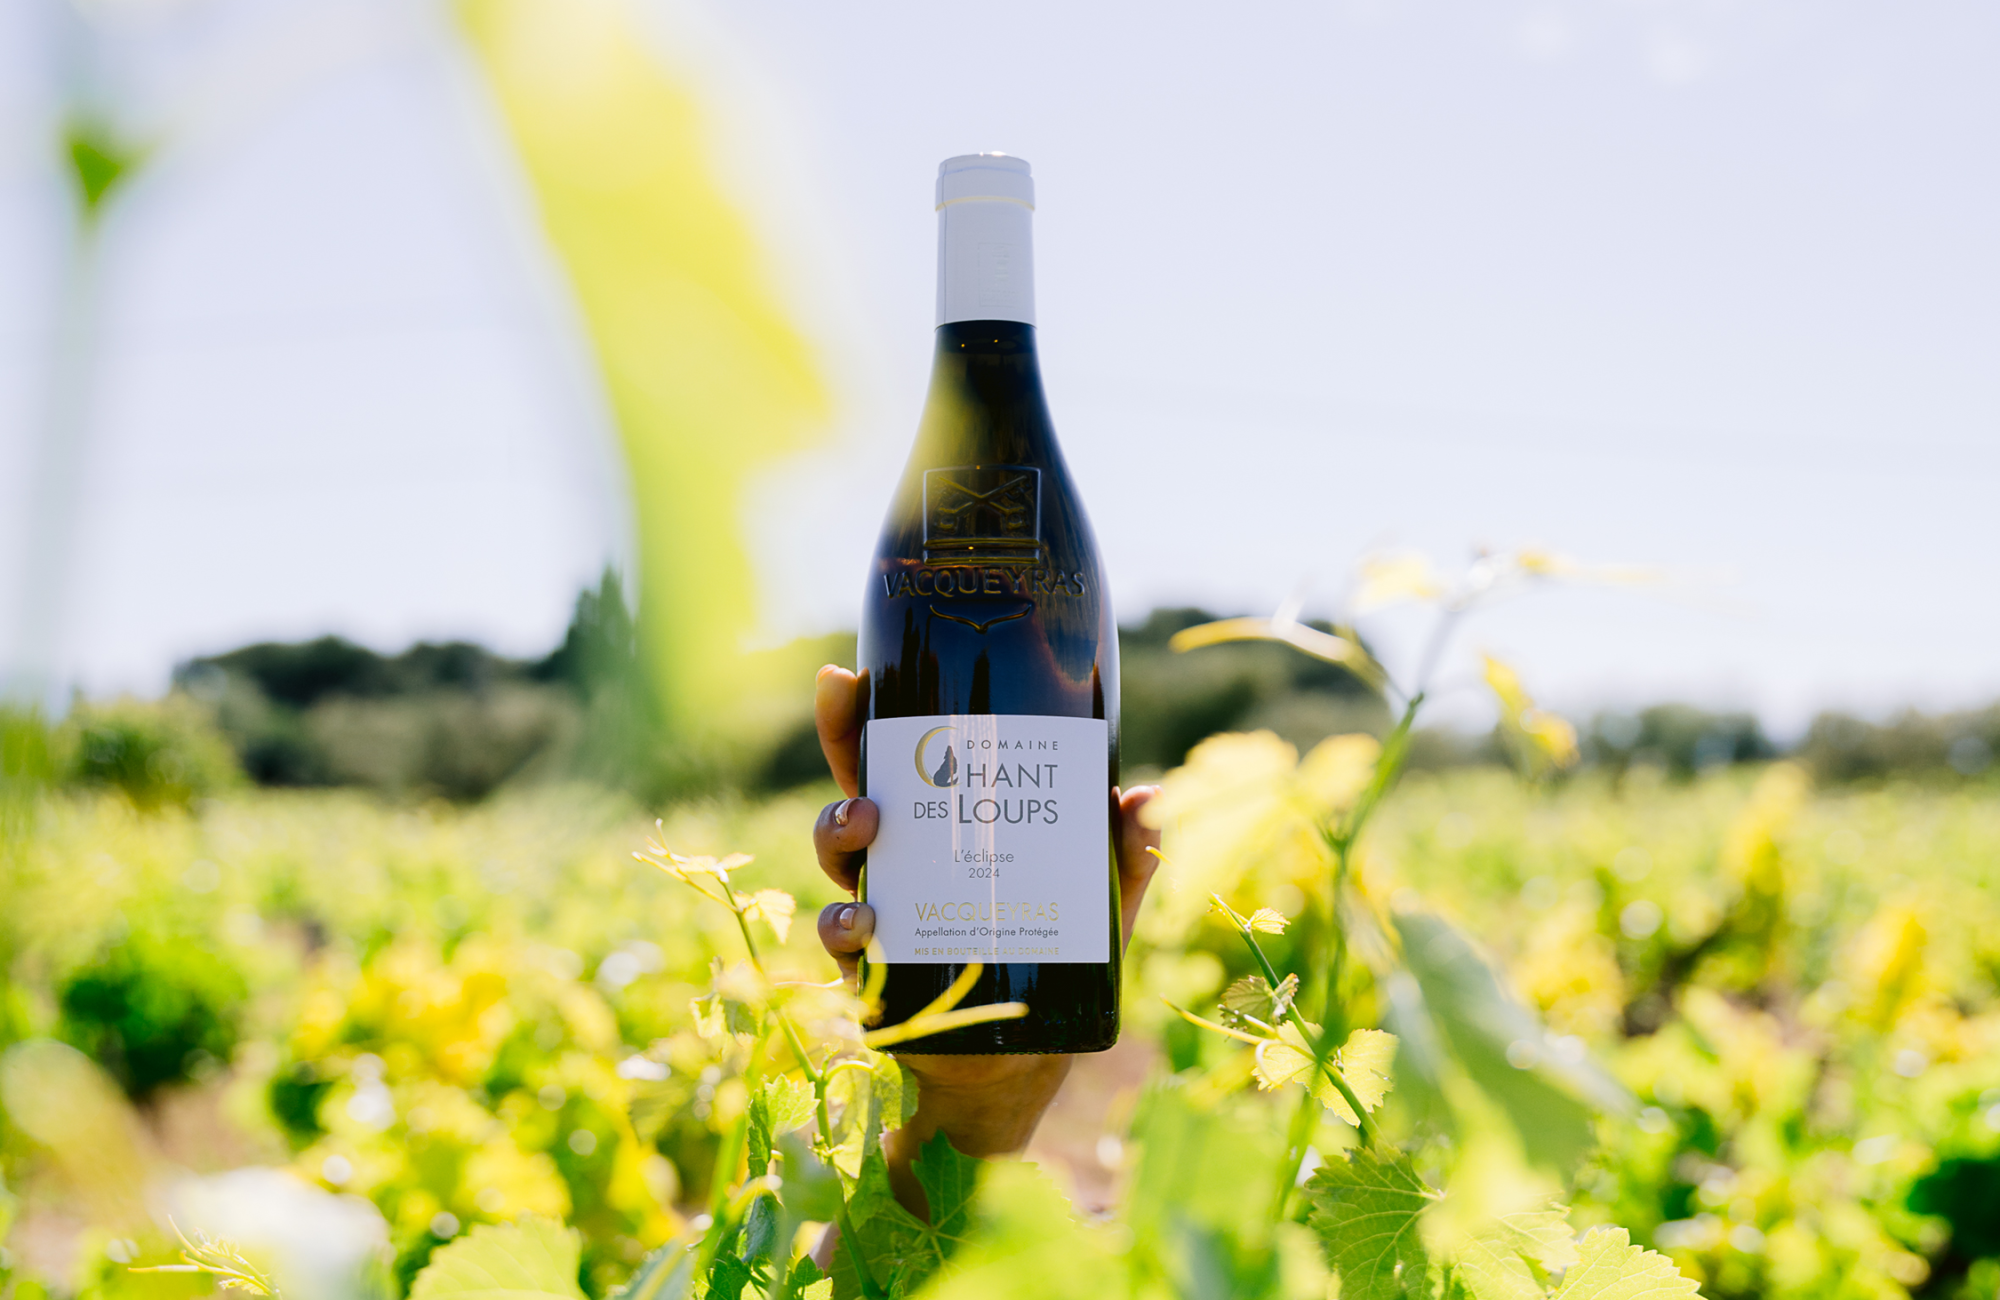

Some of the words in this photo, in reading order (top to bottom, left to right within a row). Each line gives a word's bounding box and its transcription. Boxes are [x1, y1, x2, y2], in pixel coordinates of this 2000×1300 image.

[883, 567, 1085, 598] VACQUEYRAS
[966, 739, 1059, 750] DOMAINE
[913, 801, 949, 819] DES
[958, 794, 1059, 824] LOUPS
[954, 849, 1015, 866] L’éclipse
[968, 867, 1000, 879] 2024
[915, 902, 1060, 921] VACQUEYRAS
[914, 927, 967, 938] Appellation
[1019, 926, 1059, 938] Protégée
[914, 947, 930, 955] MIS
[932, 947, 944, 955] EN
[947, 947, 999, 955] BOUTEILLE
[1002, 947, 1015, 955] AU
[1018, 947, 1060, 955] DOMAINE
